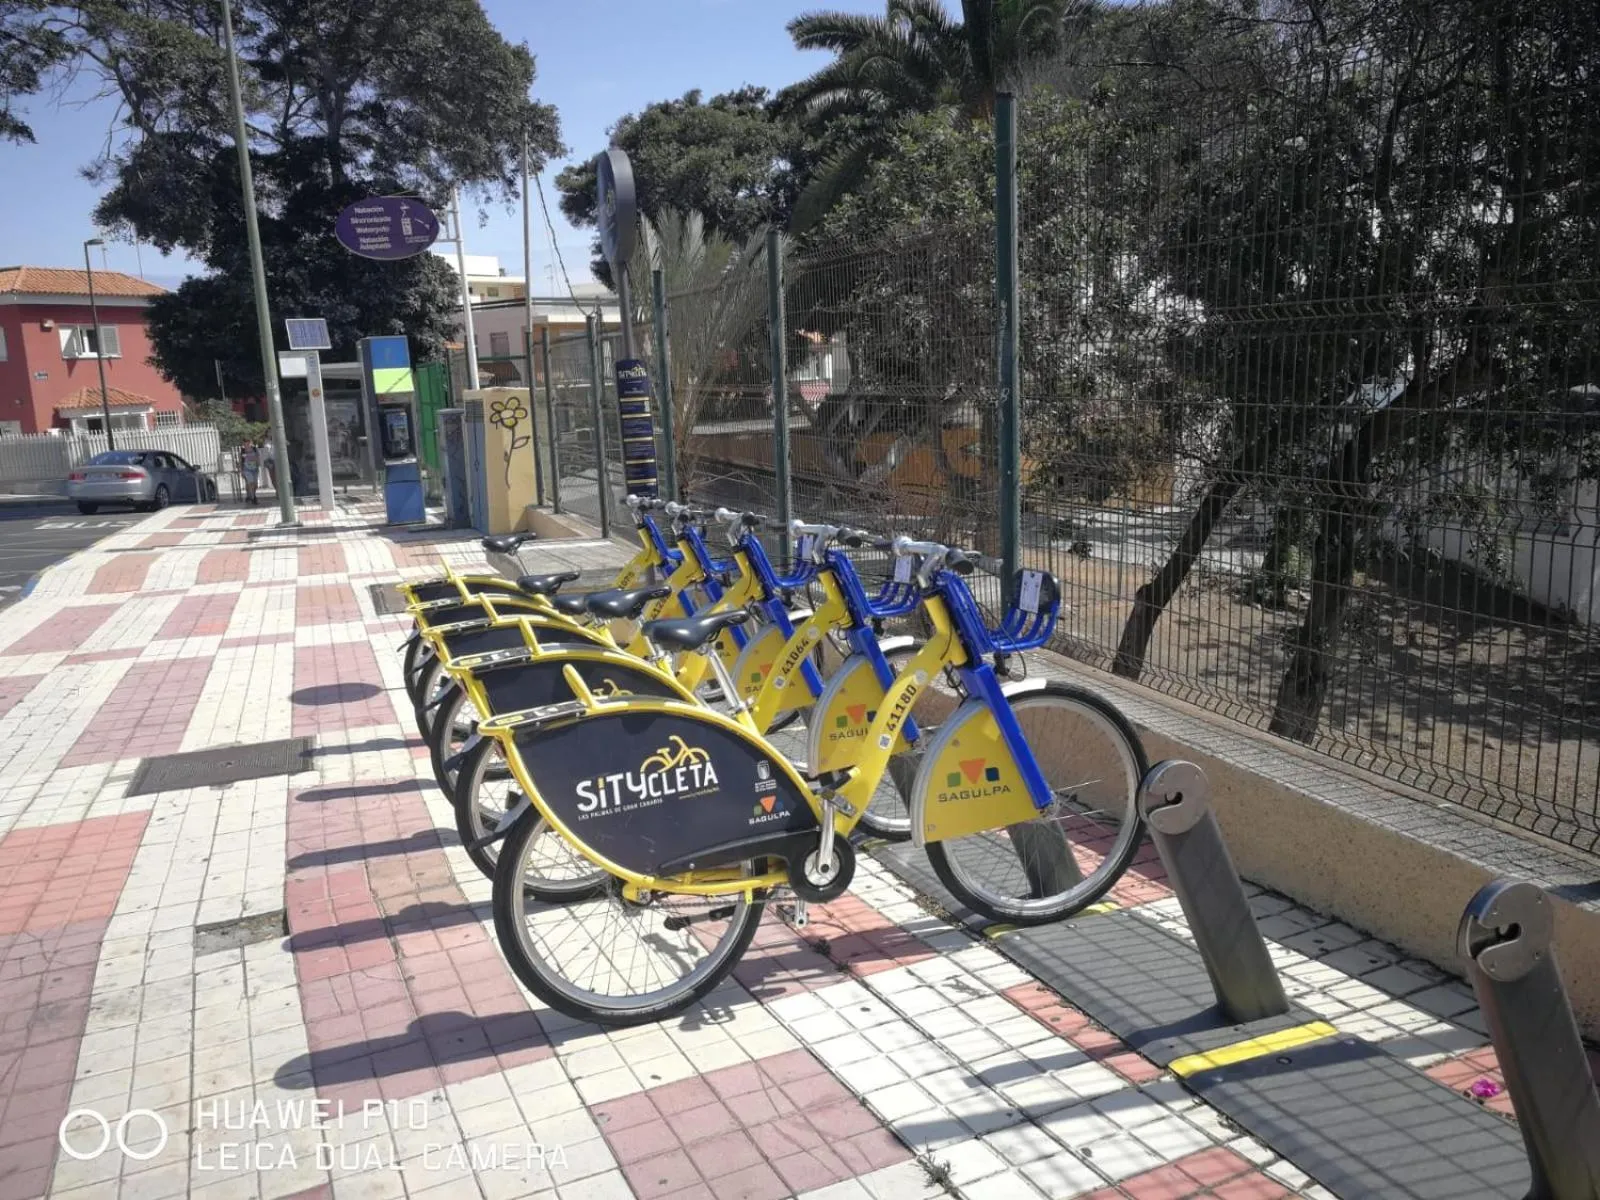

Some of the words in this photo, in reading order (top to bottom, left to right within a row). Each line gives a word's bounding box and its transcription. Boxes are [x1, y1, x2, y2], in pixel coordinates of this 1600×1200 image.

[782, 638, 809, 675] 41064
[886, 684, 917, 732] 41180
[938, 784, 1012, 802] SAGULPA
[748, 810, 791, 825] SAGULPA
